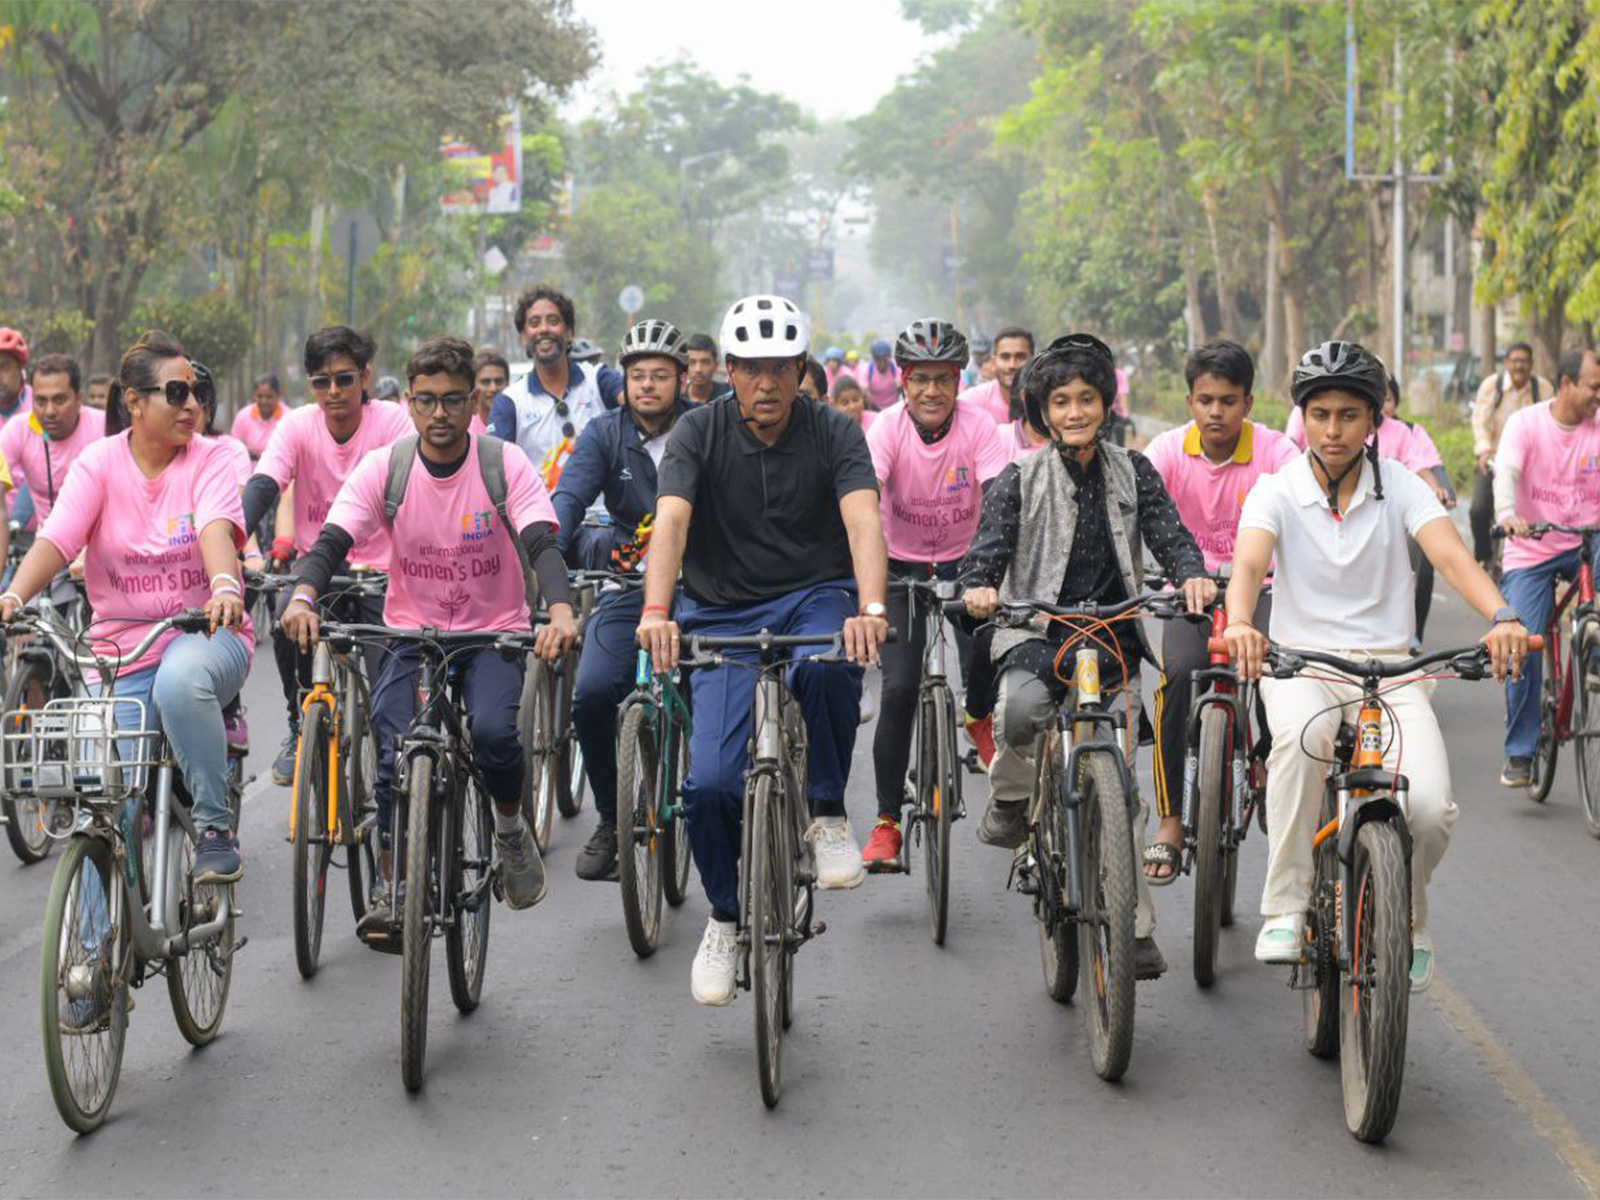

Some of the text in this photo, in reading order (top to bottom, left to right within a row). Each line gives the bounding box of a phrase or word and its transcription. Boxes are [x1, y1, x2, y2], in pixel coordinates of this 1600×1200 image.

[462, 529, 494, 541] INDIA
[125, 549, 191, 565] International
[419, 543, 484, 558] International
[471, 554, 501, 577] Day
[106, 566, 210, 595] Women's Day
